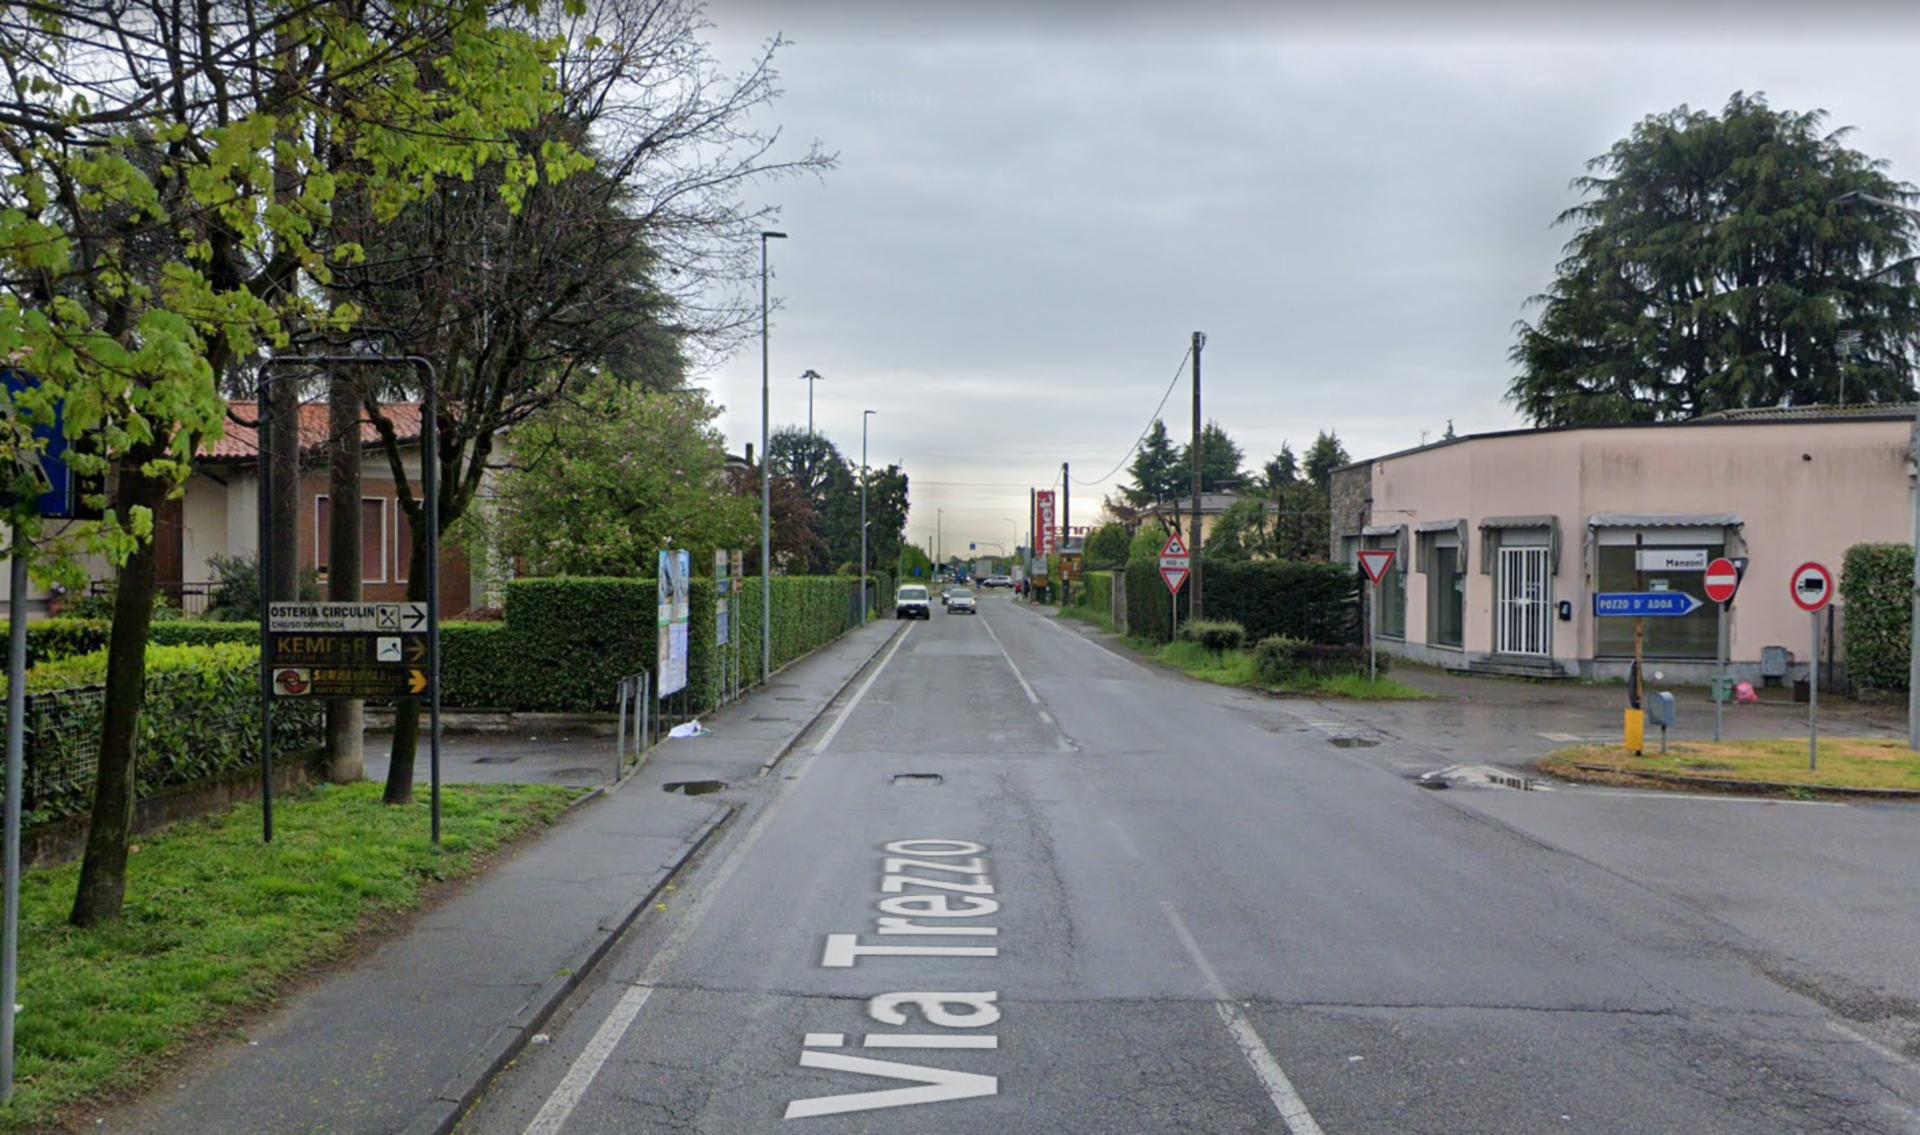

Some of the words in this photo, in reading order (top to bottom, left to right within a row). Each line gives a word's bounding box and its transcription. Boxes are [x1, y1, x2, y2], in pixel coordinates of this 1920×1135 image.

[1666, 559, 1704, 567] Manzoni
[1600, 599, 1629, 609] POZZO
[1634, 599, 1644, 609] D'
[1648, 599, 1673, 609] ADDA
[270, 606, 319, 617] OSTERIA
[322, 606, 375, 617] CIRCULIN
[277, 637, 367, 653] KEMPER
